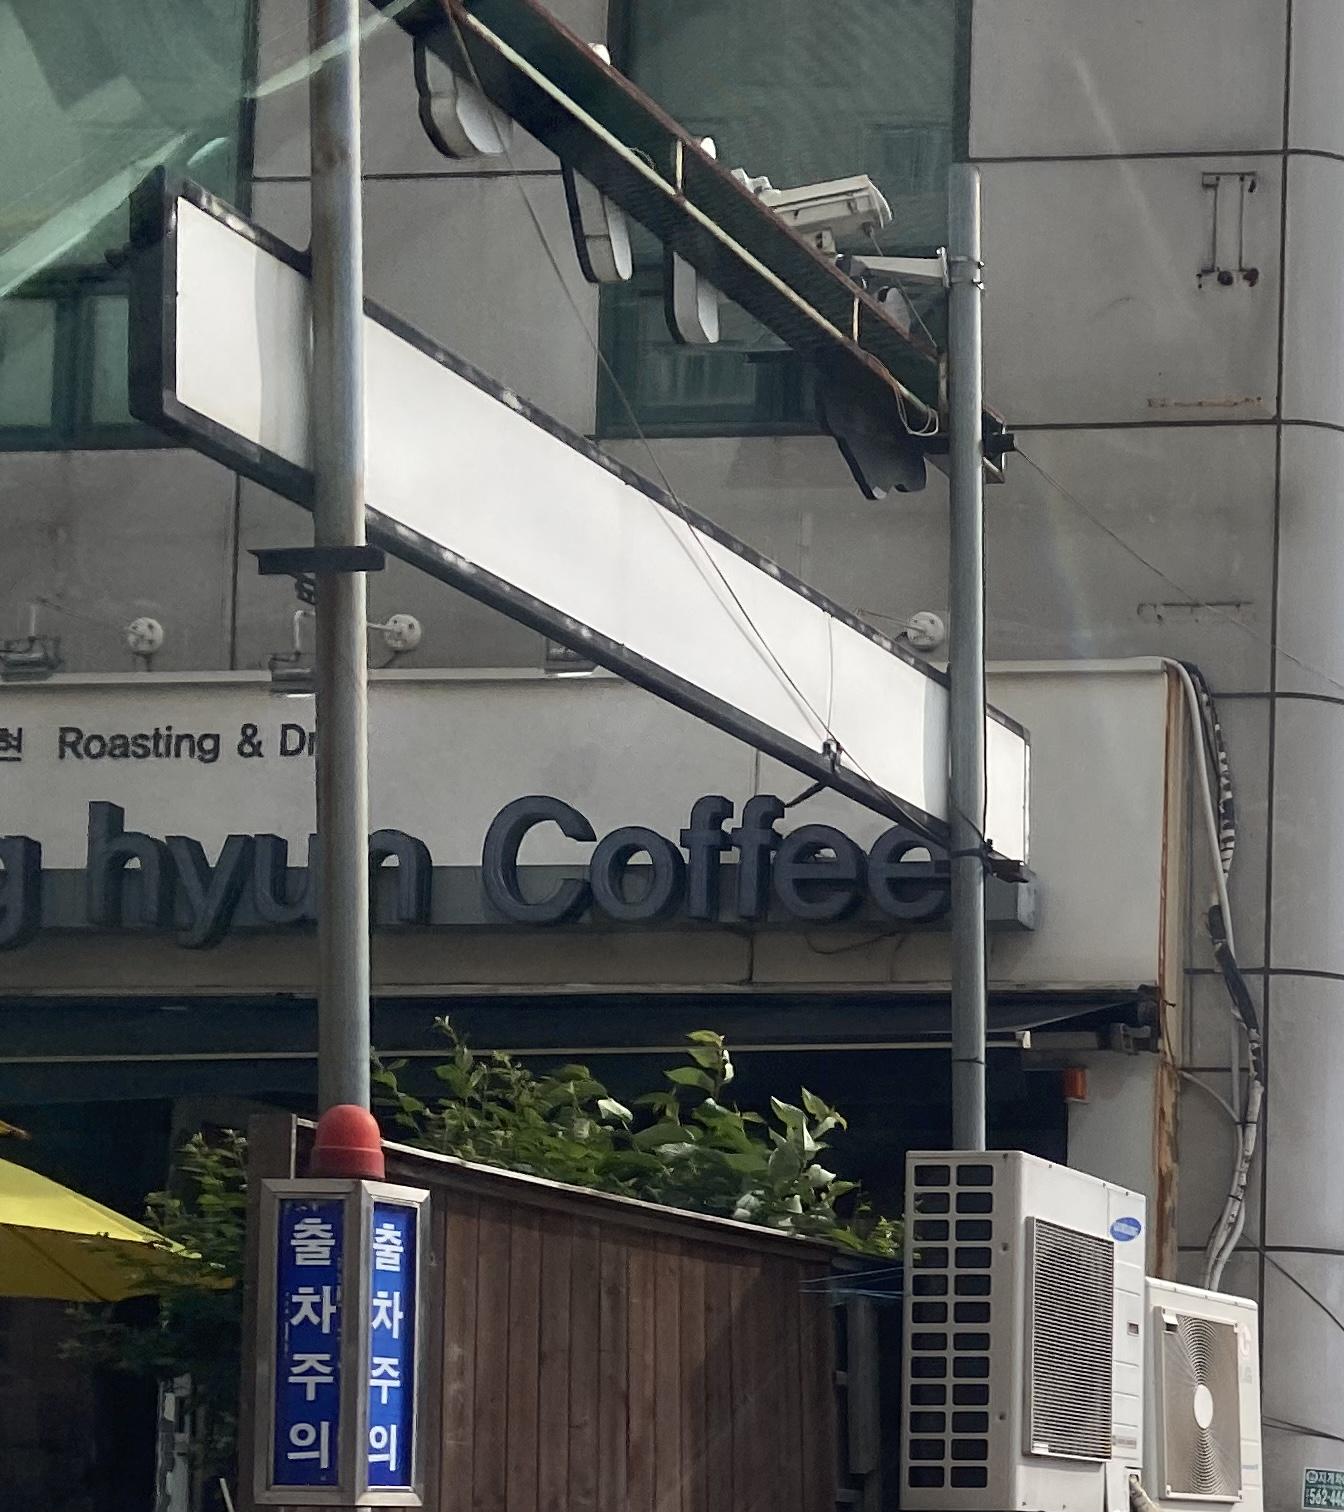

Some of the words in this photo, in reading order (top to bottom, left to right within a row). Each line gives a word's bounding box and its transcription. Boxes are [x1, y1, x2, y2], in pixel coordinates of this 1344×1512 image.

[58, 725, 221, 763] Roasting
[237, 723, 264, 758] &
[482, 794, 951, 925] Coffee
[286, 1217, 337, 1471] 출차주의
[367, 1222, 405, 1473] 출차주의
